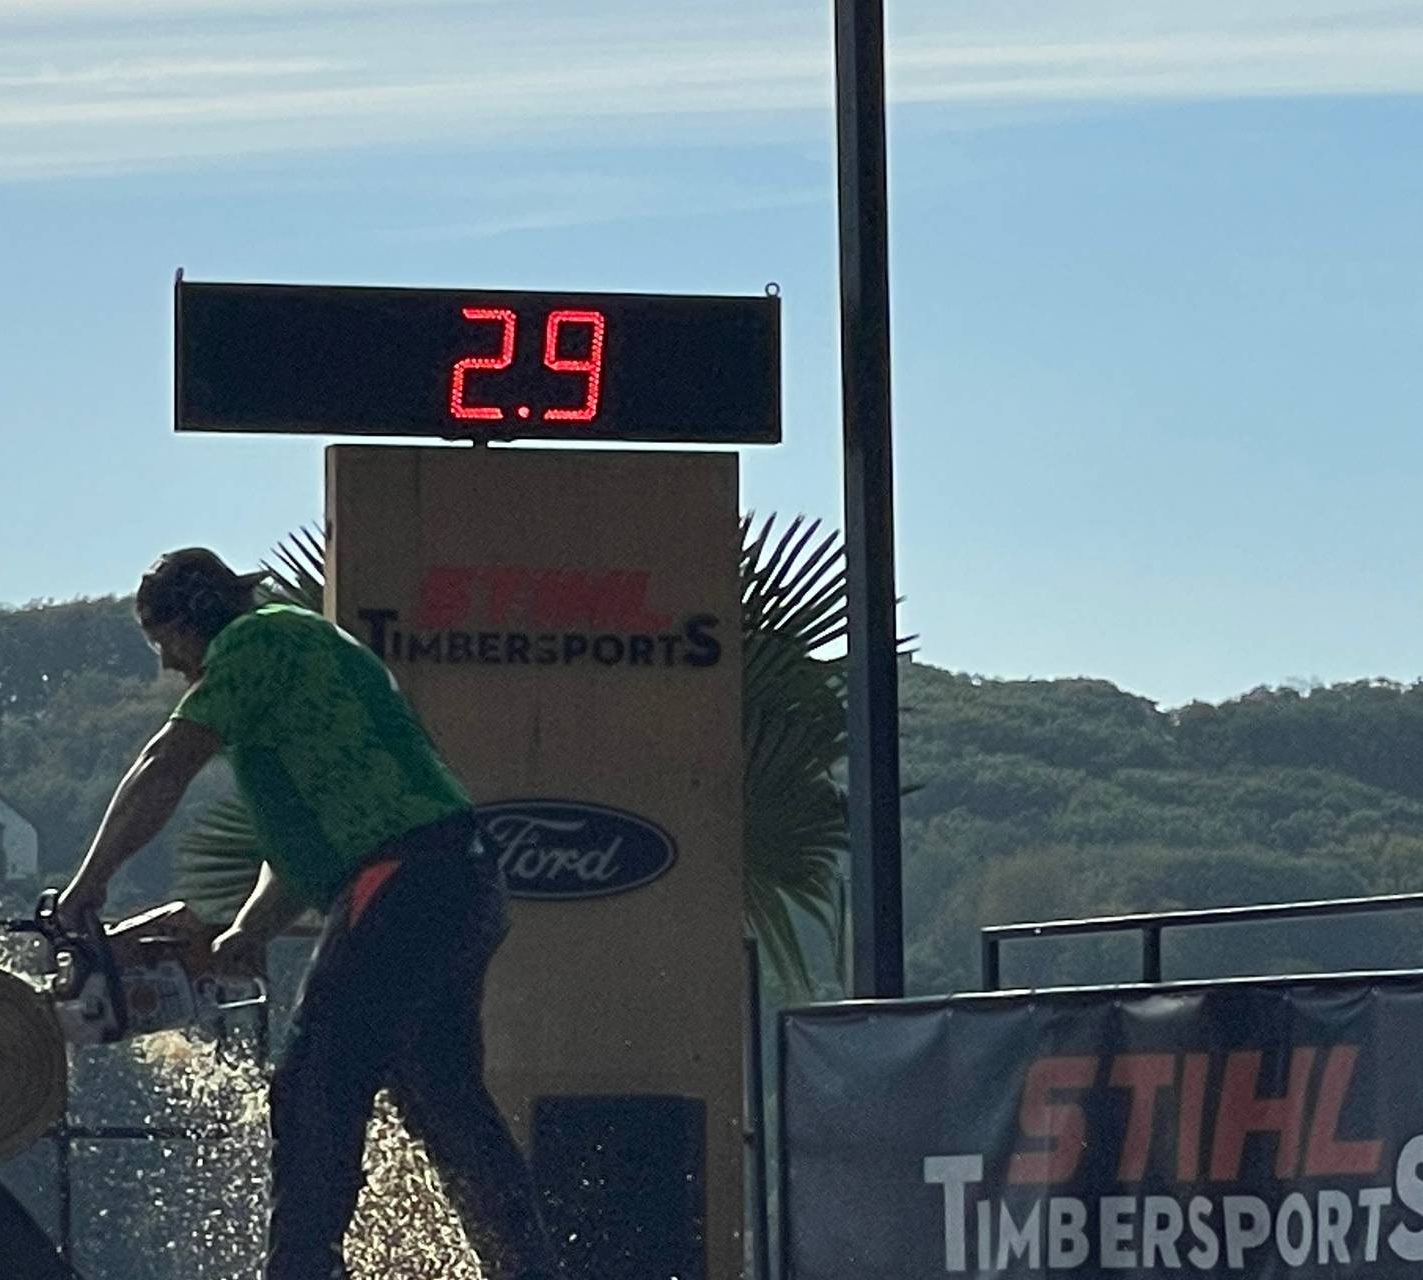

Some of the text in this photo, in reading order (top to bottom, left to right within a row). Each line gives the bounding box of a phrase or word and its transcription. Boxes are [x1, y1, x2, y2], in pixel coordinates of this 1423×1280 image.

[450, 308, 605, 420] 2.9
[415, 565, 674, 631] STIHL
[358, 608, 722, 668] TIMBERSPORTS
[487, 814, 624, 881] Ford
[1006, 1043, 1385, 1185] STIHL
